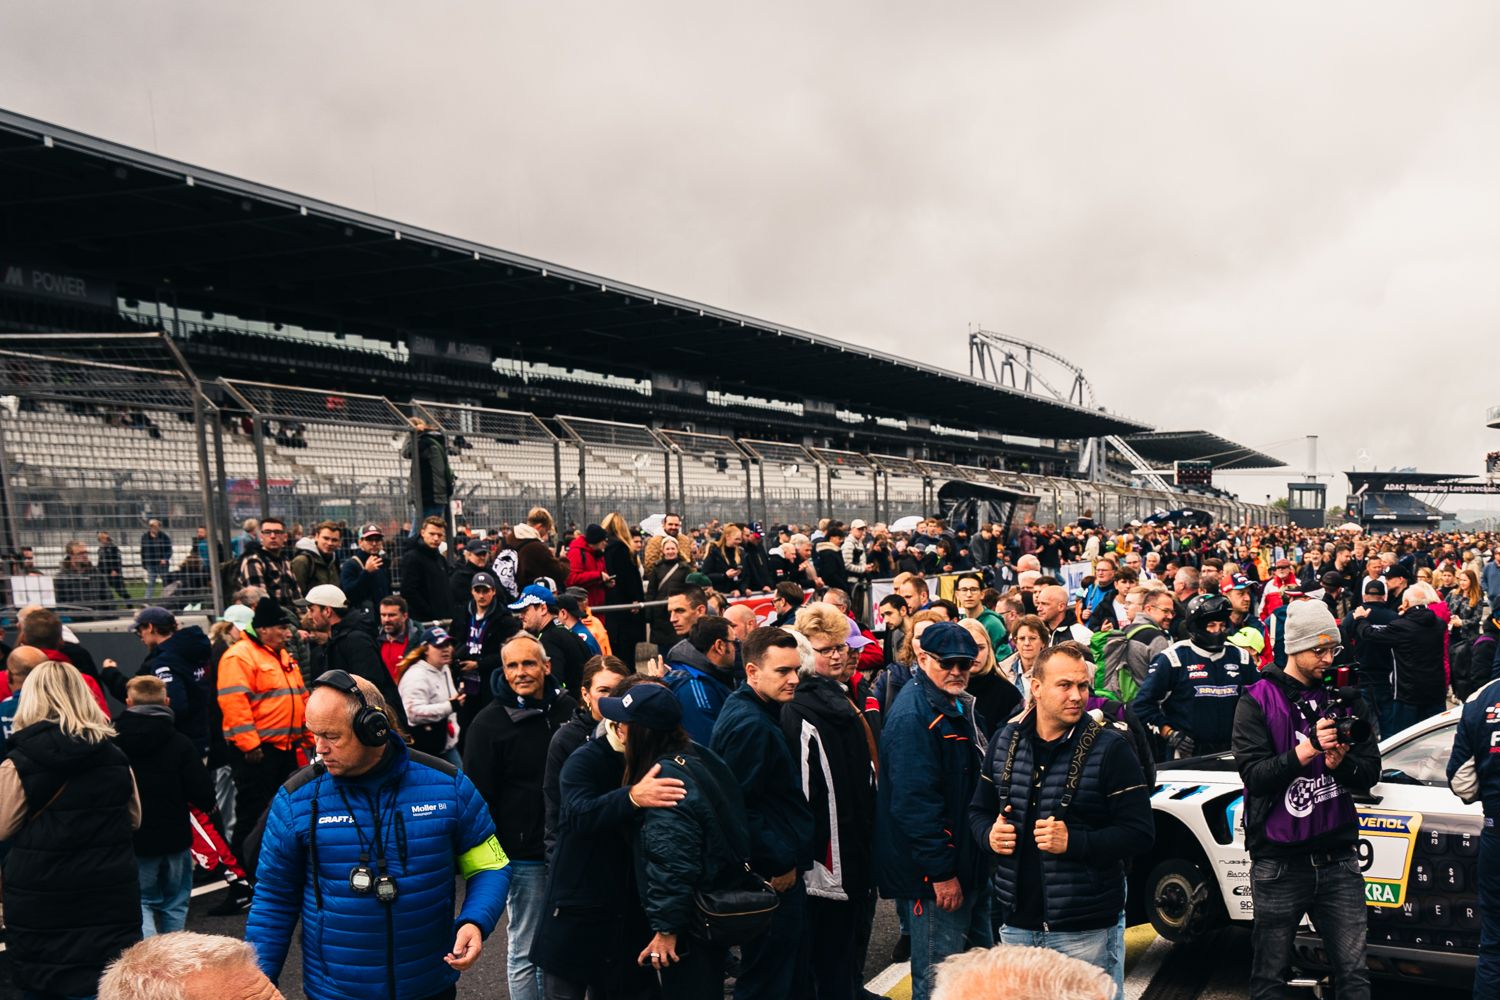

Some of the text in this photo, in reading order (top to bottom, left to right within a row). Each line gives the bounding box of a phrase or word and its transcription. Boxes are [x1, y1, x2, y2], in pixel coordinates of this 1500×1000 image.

[1405, 483, 1449, 493] Nürburgring
[318, 816, 349, 825] CRAFT
[1435, 904, 1442, 915] E
[1466, 907, 1474, 918] R
